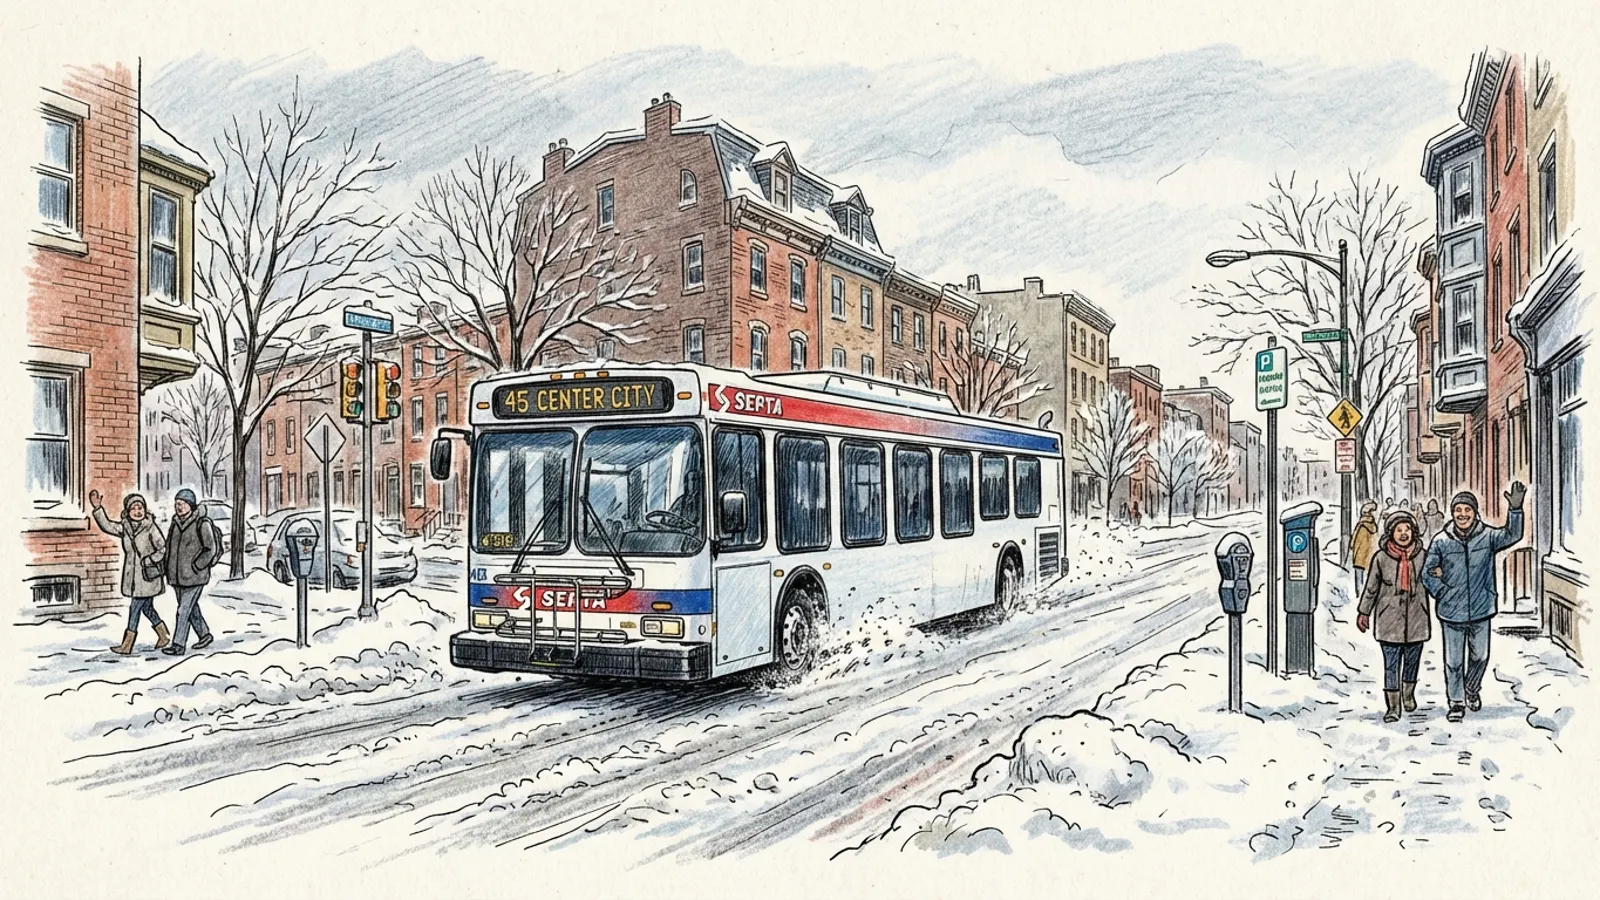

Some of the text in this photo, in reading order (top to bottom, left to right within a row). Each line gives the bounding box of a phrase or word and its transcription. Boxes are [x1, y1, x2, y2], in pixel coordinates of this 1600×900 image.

[1261, 354, 1270, 370] P
[504, 384, 656, 414] 45 CENTER CITY
[734, 391, 782, 415] SEPTA
